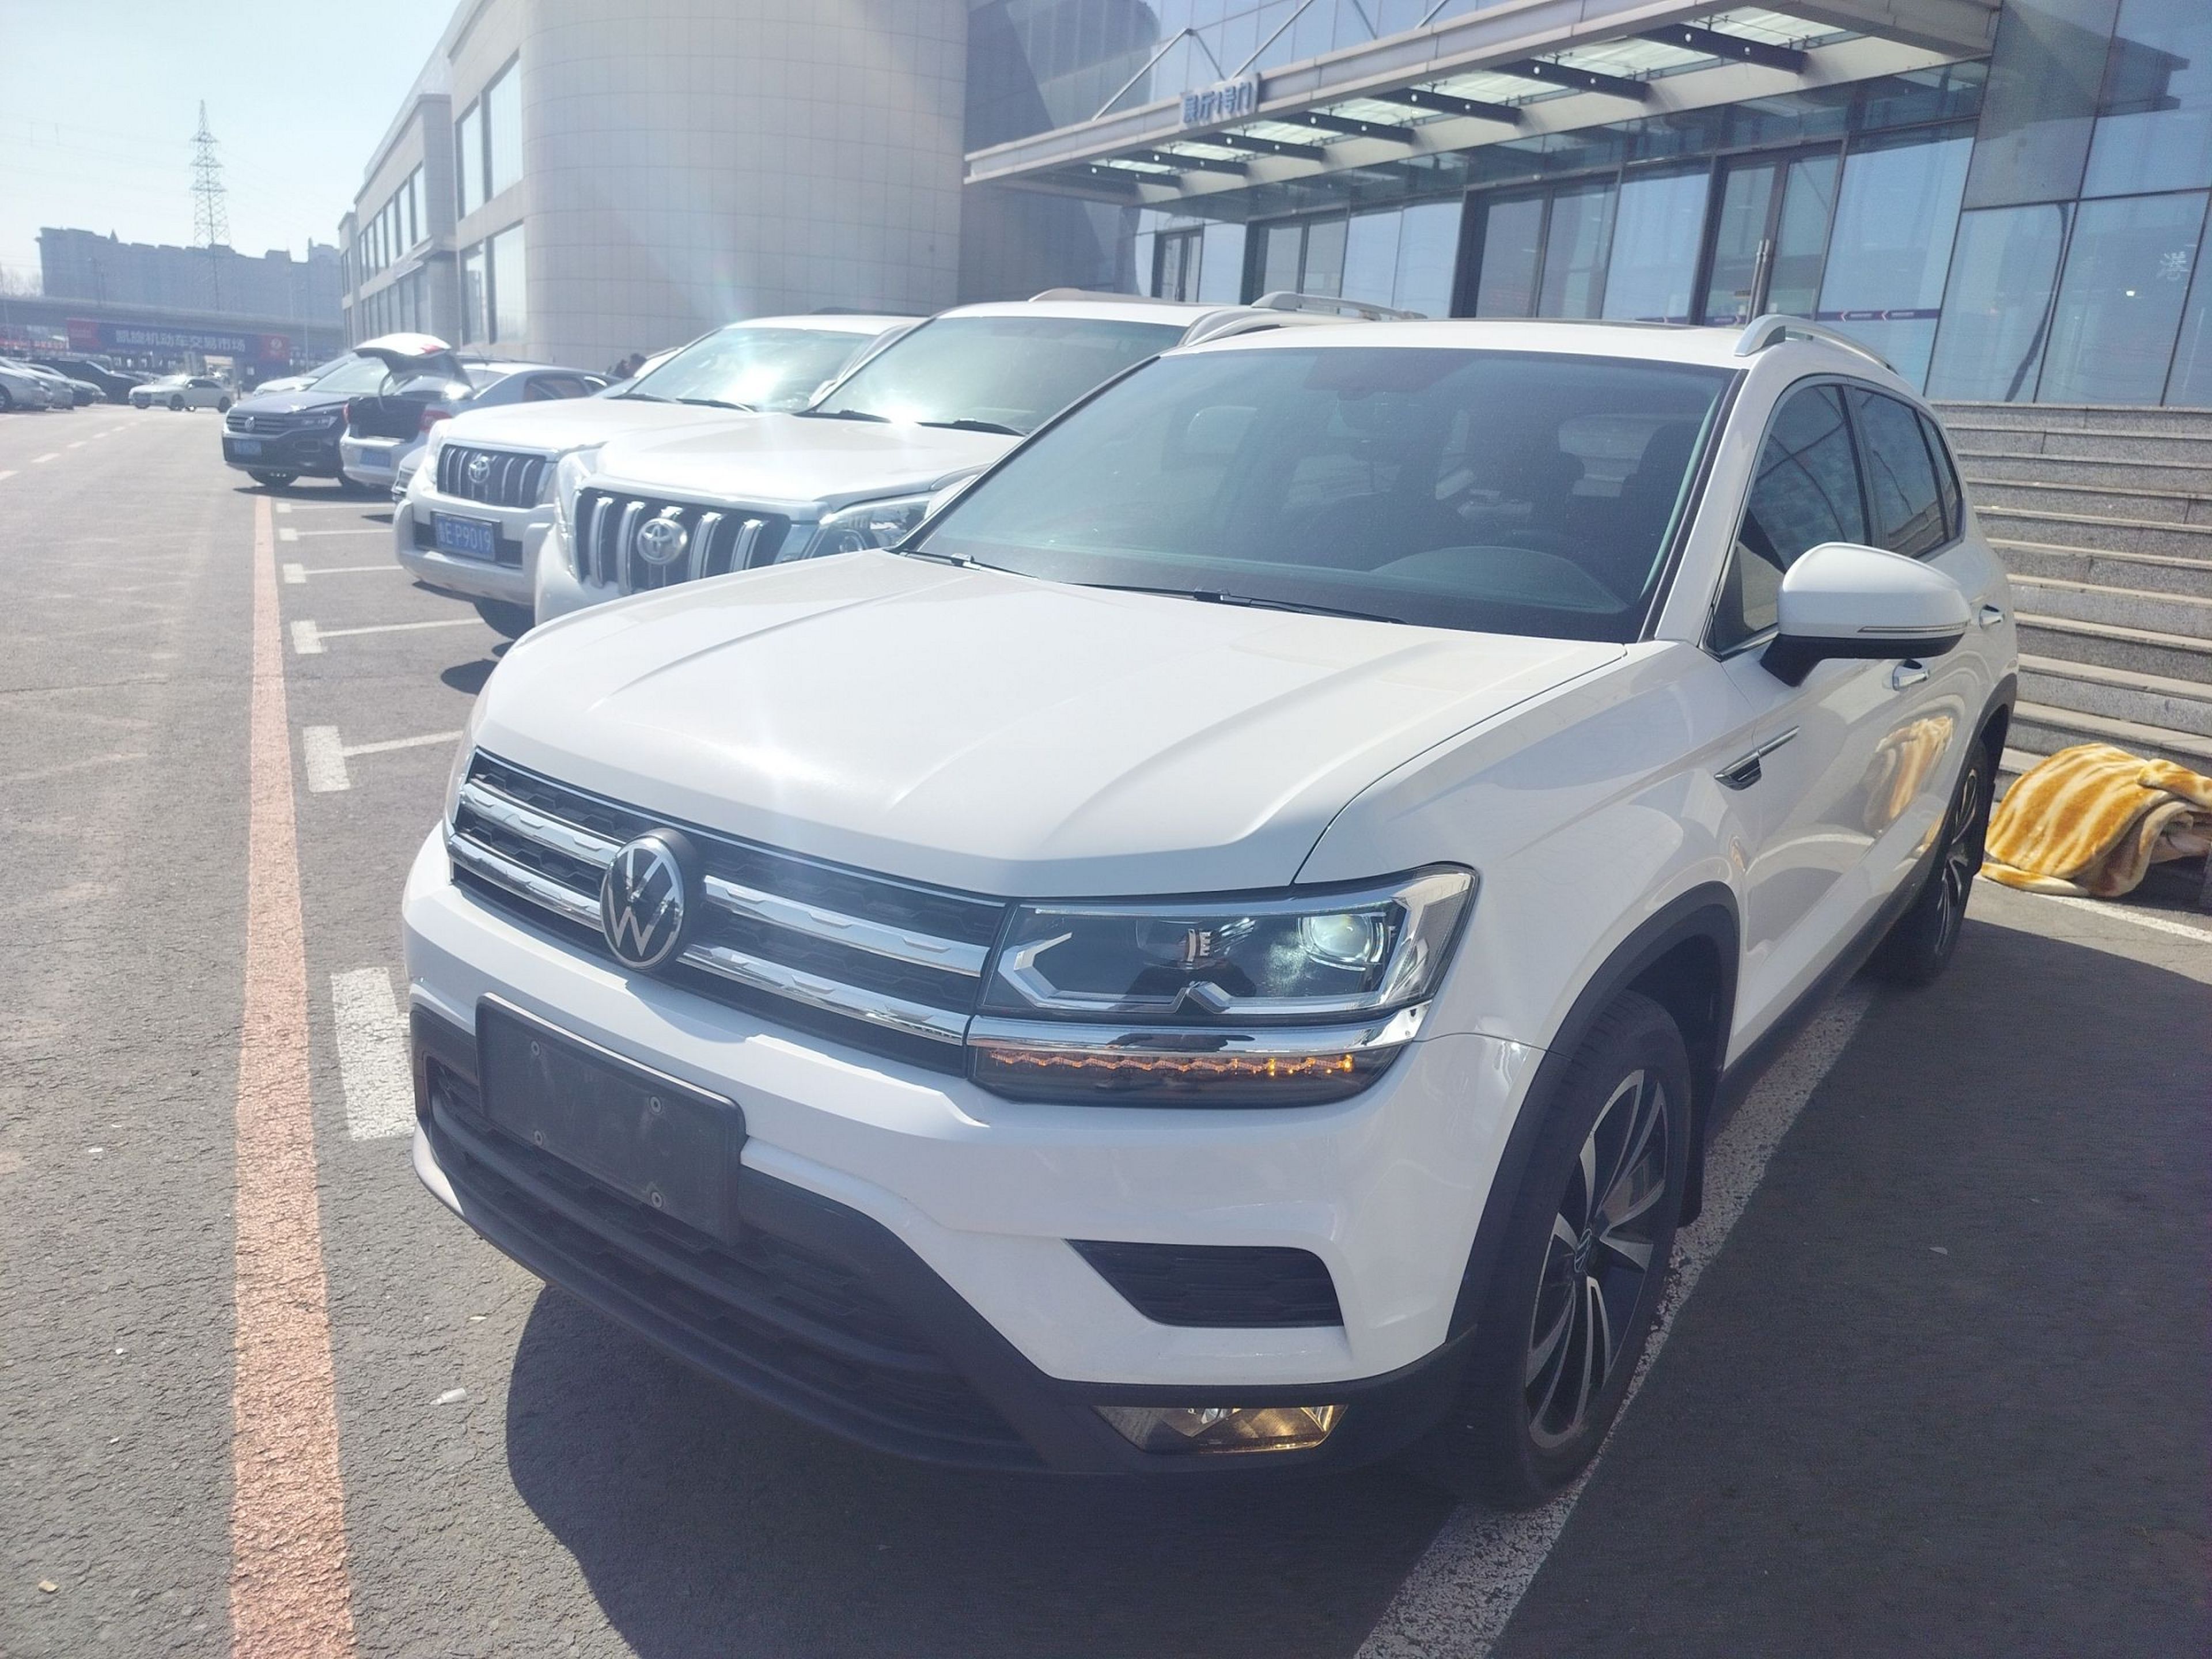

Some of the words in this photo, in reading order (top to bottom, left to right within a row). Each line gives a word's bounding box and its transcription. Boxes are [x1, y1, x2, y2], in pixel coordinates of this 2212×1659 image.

[115, 329, 245, 353] 凯旋机动车交易市场
